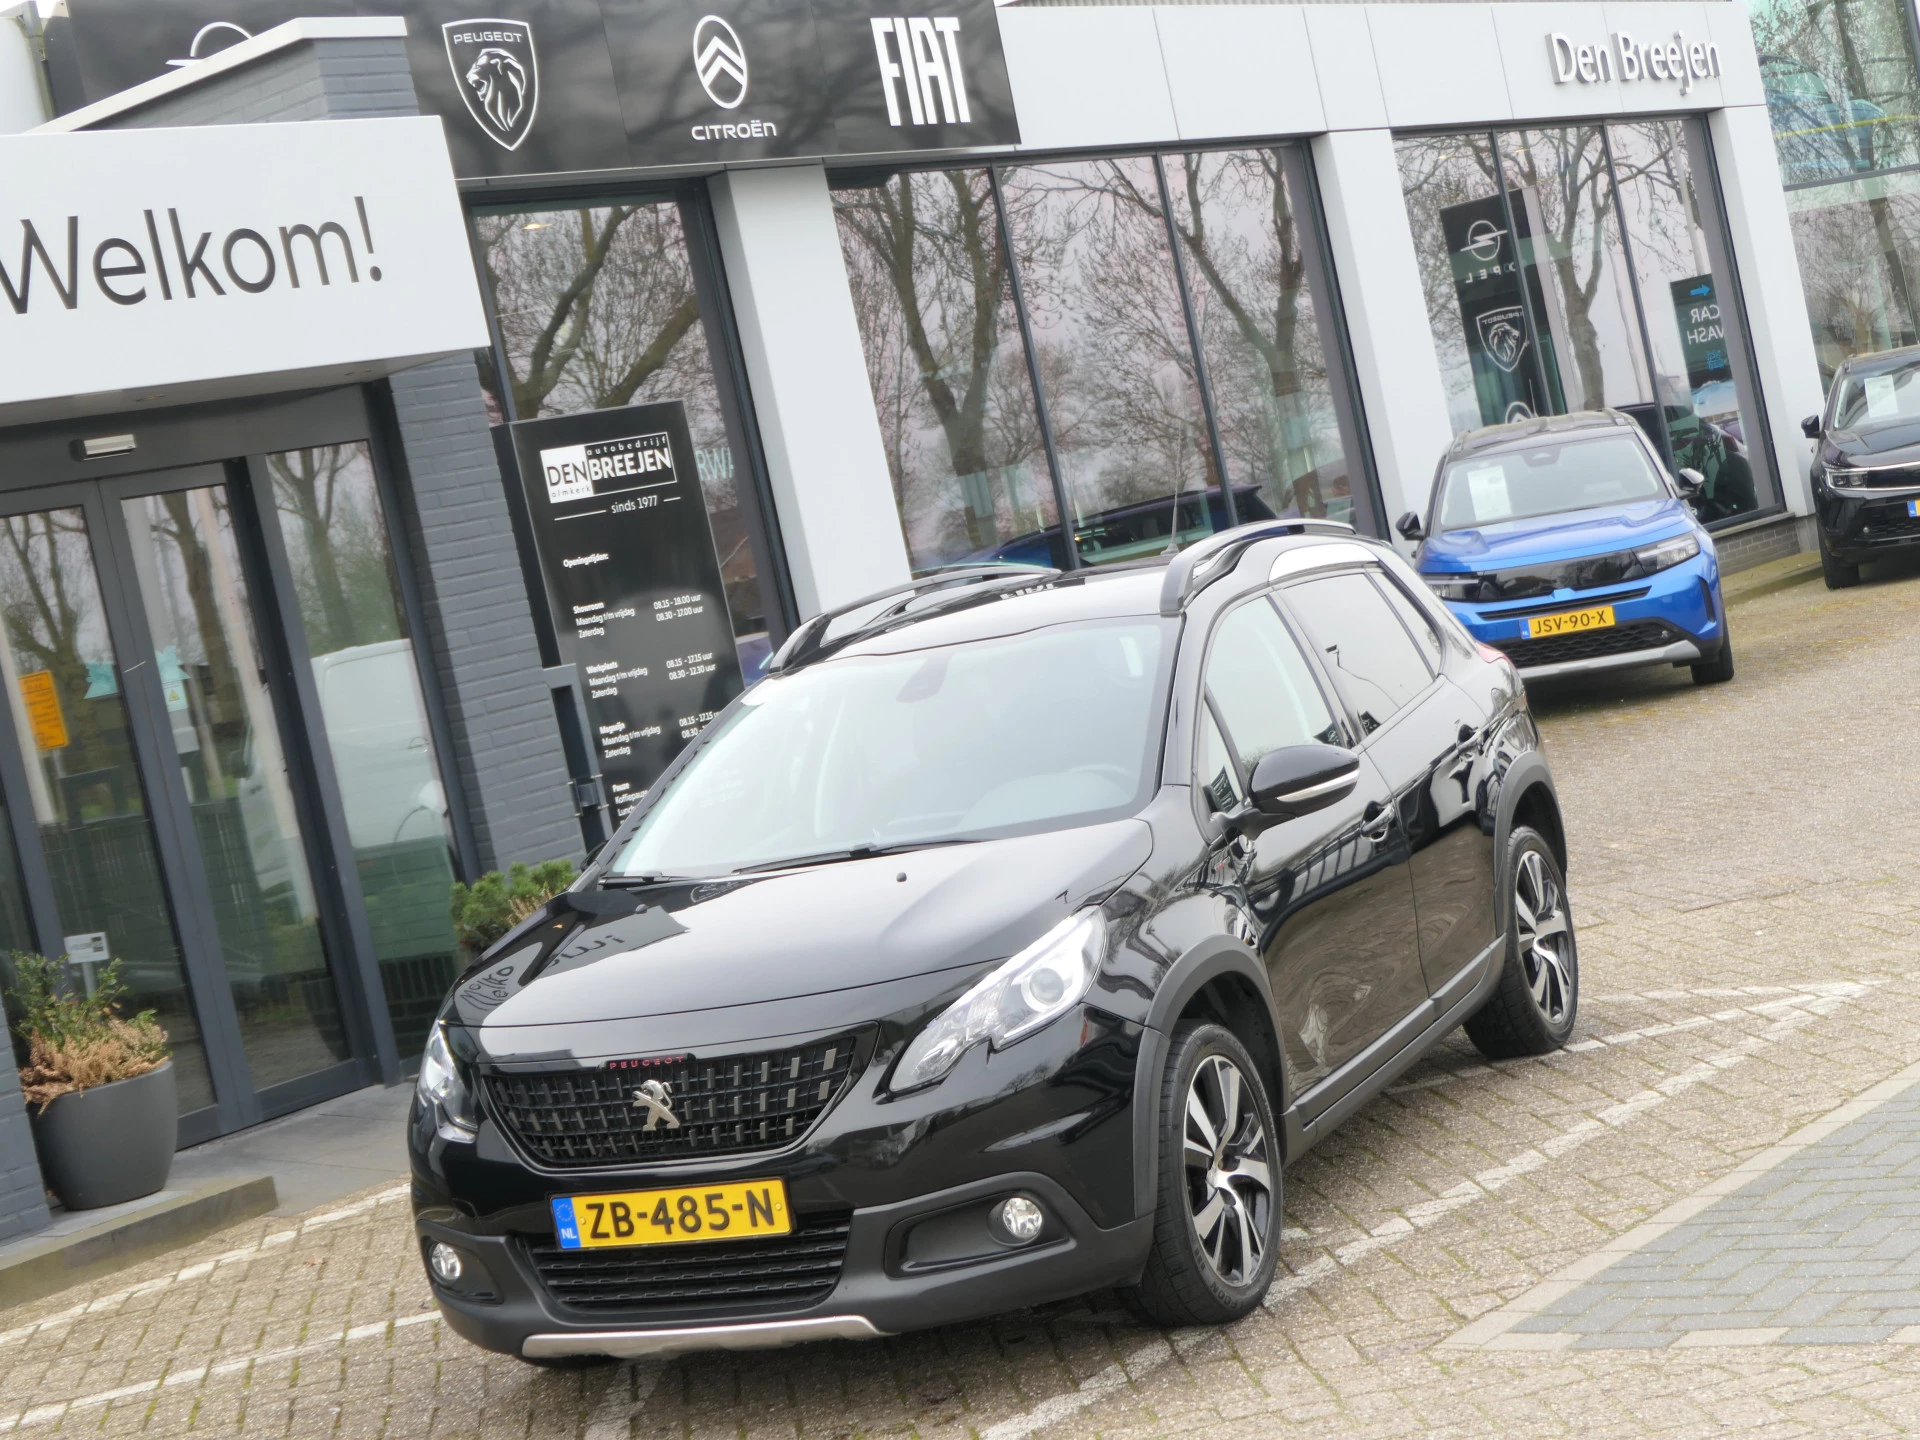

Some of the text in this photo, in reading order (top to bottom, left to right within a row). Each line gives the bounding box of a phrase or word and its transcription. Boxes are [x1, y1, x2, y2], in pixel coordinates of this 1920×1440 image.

[453, 31, 522, 45] PEUGEOT
[1545, 29, 1723, 96] Den Breejen
[869, 16, 971, 127] FIAT
[0, 195, 383, 315] Welkom!
[586, 435, 667, 456] autobedrijf
[546, 448, 673, 487] DEN BREEJEN
[551, 486, 591, 498] almkerk
[611, 495, 659, 514] sinds 1977
[573, 601, 605, 614] Showroom
[653, 600, 669, 611] 08.15
[691, 594, 702, 604] uur
[576, 613, 604, 627] Maandag
[614, 607, 635, 620] vrijdag
[656, 610, 672, 622] 08.30
[692, 605, 704, 615] uur
[1534, 610, 1607, 635] JSV-90-X
[578, 627, 605, 639] Zaterdag
[586, 661, 618, 674] Werkplaats
[666, 658, 683, 669] 08.15
[702, 652, 713, 661] uur
[589, 673, 617, 686] Maandag
[627, 667, 648, 679] vrijdag
[669, 670, 686, 681] 08.30
[705, 663, 716, 673] uur
[591, 686, 618, 699] Zaterdag
[679, 715, 695, 727] 08.15
[602, 733, 630, 747] Maandag
[640, 726, 661, 738] vrijdag
[605, 746, 631, 759] Zaterdag
[609, 1055, 684, 1070] PEUGEOT
[561, 1188, 776, 1240] NL ZB-485-N
